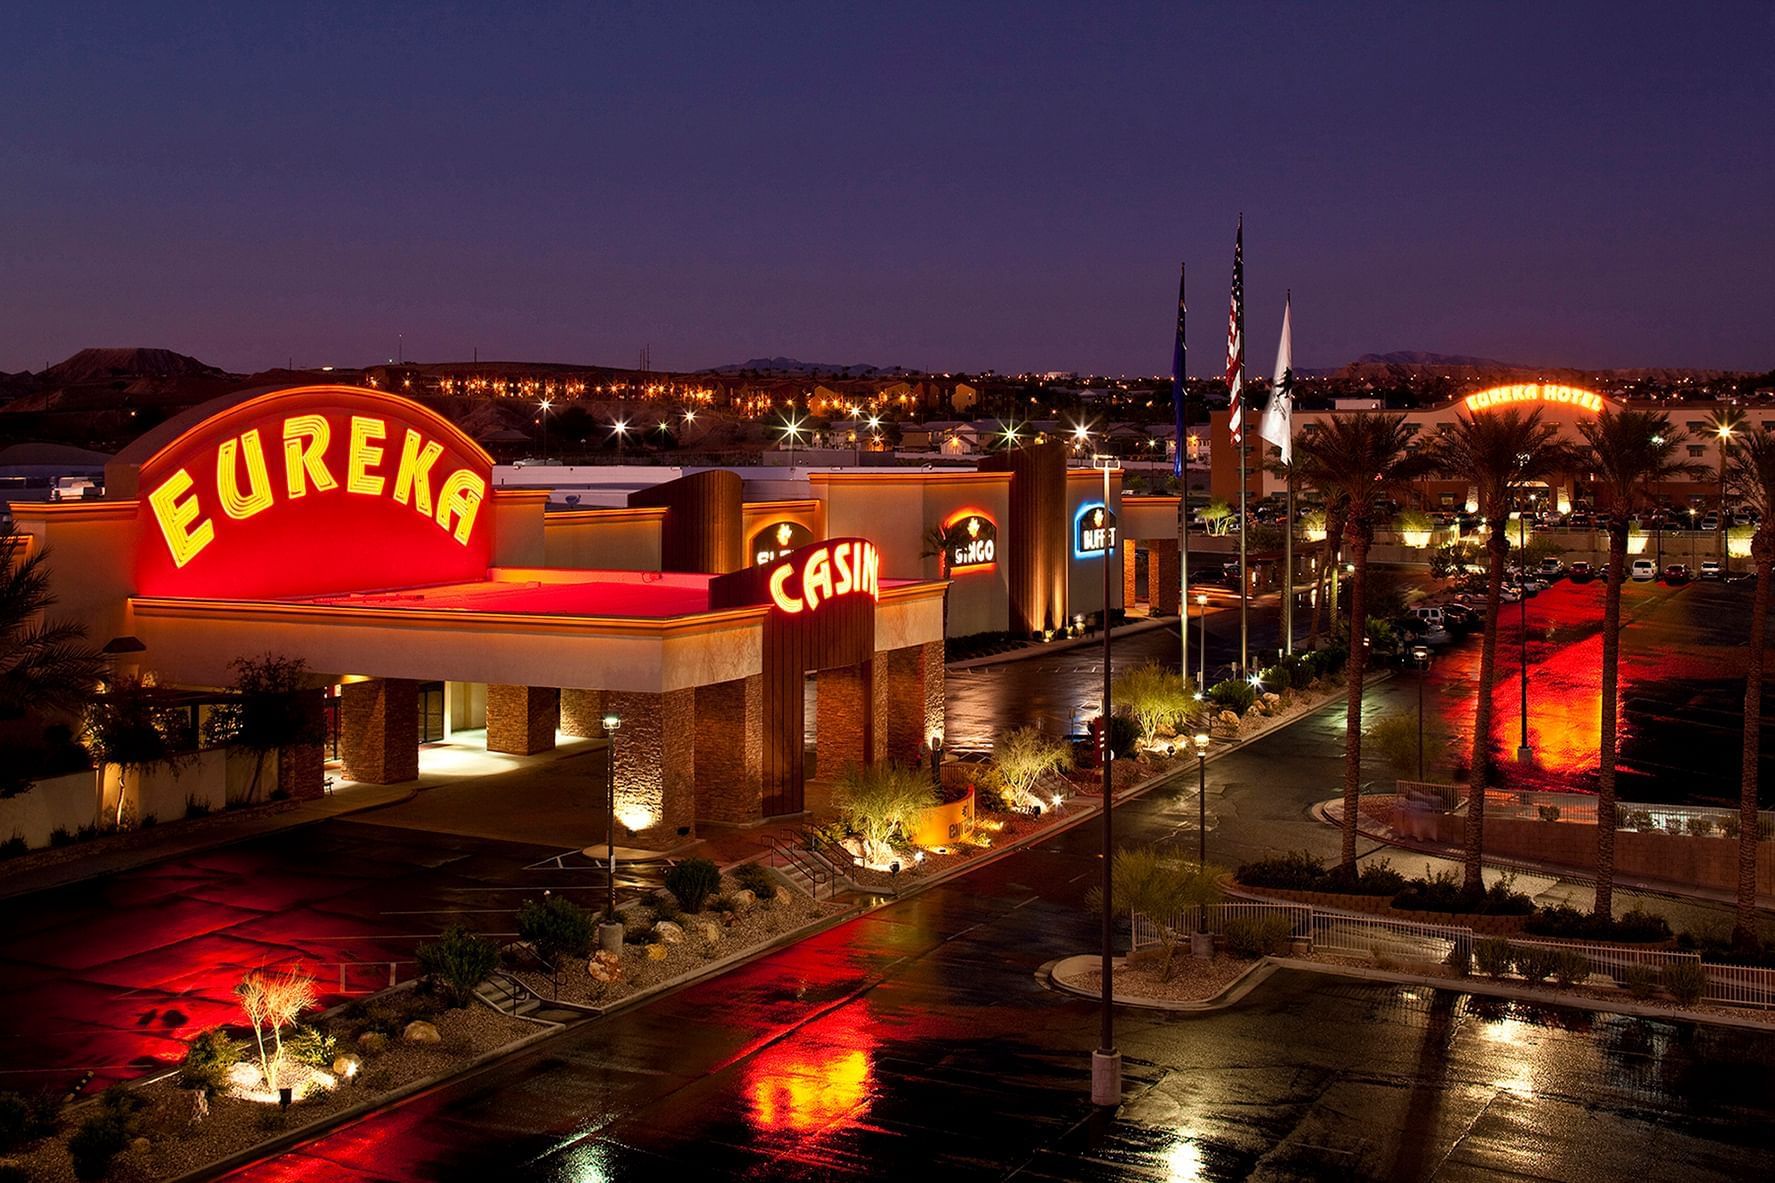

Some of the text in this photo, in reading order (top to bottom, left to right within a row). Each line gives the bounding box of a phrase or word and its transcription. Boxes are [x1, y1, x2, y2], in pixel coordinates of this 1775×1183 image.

[1465, 384, 1603, 412] EUREKA HOTEL
[148, 414, 486, 569] EUREKA
[1083, 527, 1116, 550] BUFFT
[769, 541, 879, 613] CASIN
